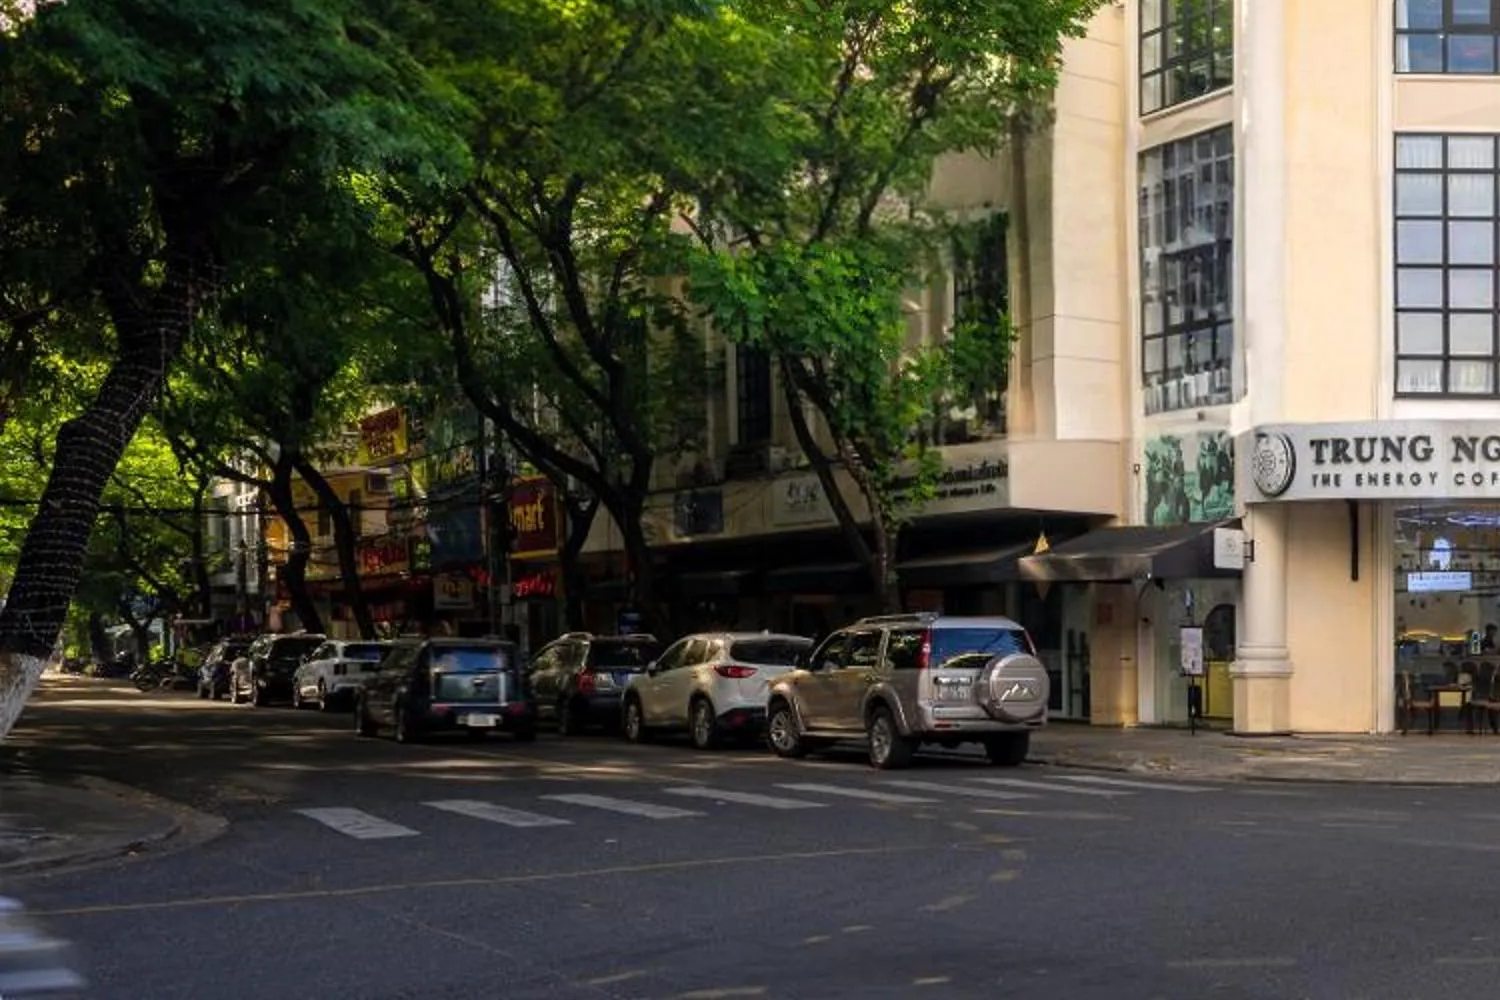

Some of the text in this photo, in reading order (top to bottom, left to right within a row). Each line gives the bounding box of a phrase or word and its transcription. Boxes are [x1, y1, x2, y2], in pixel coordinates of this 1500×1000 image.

[1309, 435, 1434, 464] TRUNG
[1311, 472, 1342, 488] THE
[1355, 471, 1438, 488] ENERGY
